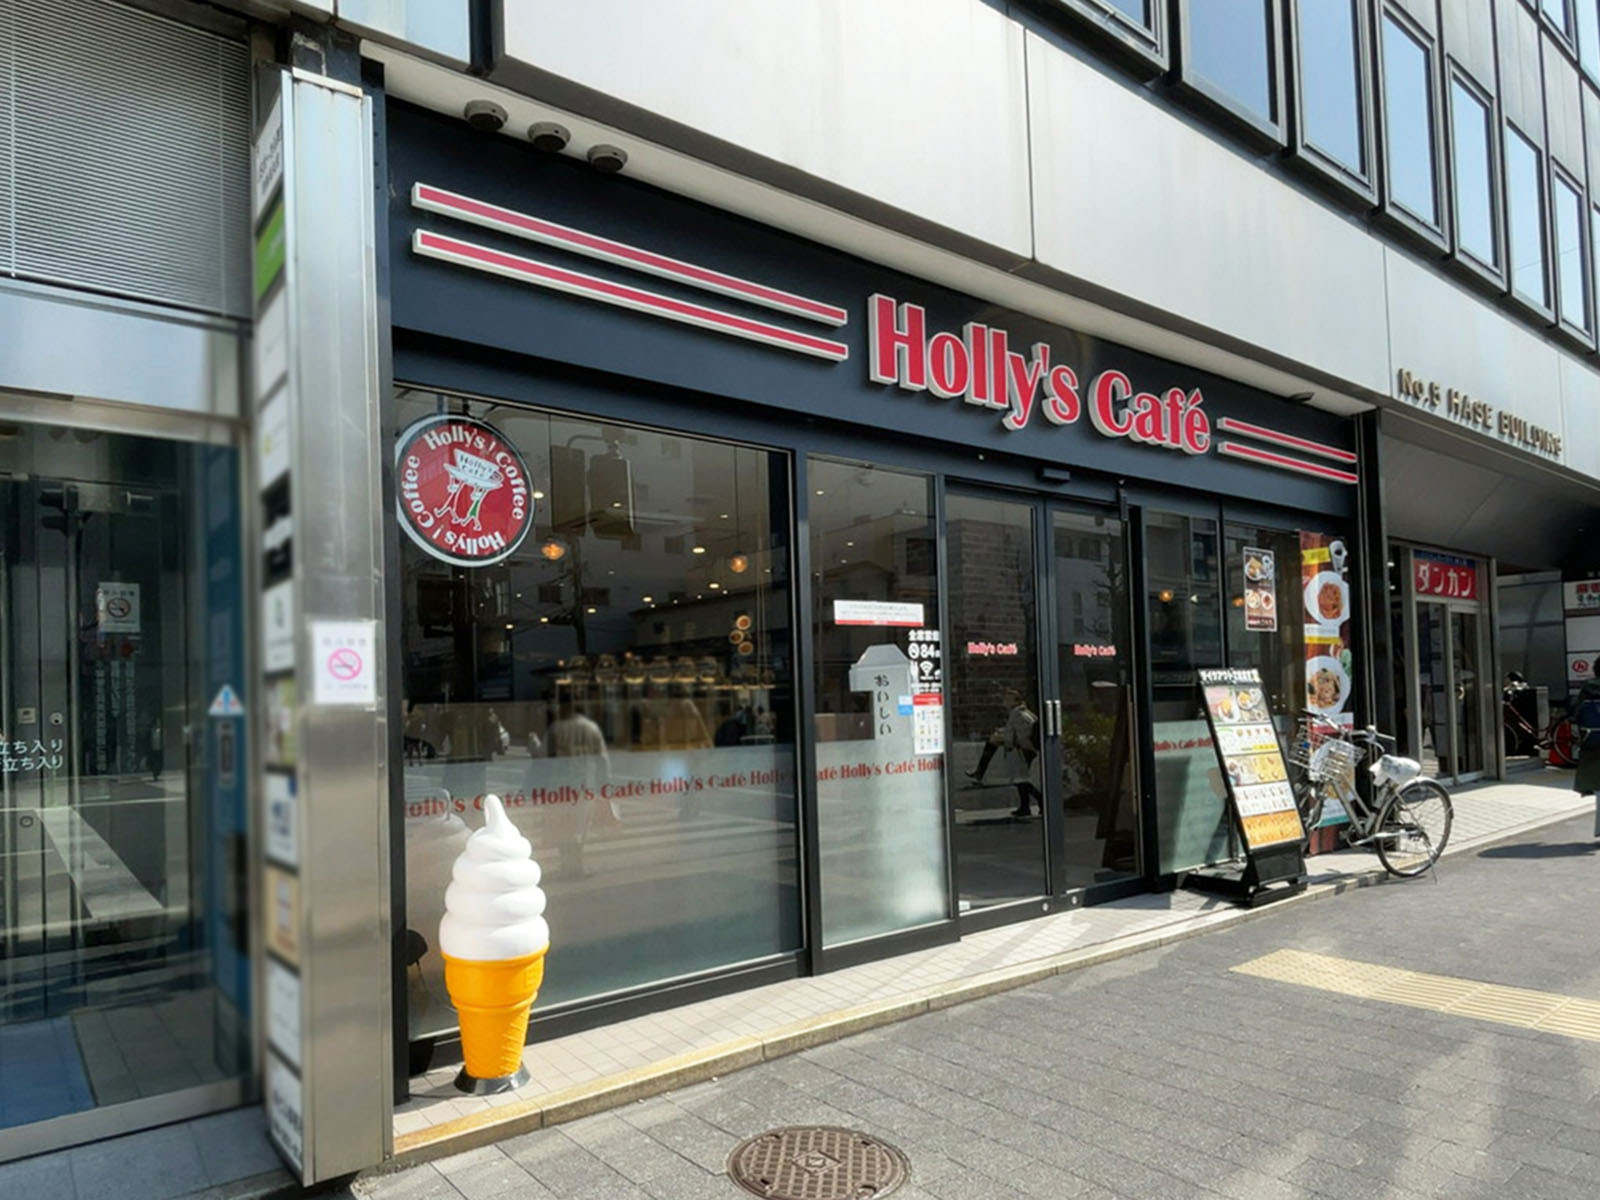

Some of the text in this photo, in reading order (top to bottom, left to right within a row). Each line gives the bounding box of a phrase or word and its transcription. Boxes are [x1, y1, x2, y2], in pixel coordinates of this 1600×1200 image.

[868, 292, 1211, 455] Holly's Café
[1446, 387, 1493, 430] HASE
[401, 455, 435, 529] Coffee
[422, 425, 486, 451] Holly's
[495, 451, 527, 520] Coffee
[444, 530, 506, 556] Holly's
[1418, 562, 1472, 597] ダンカン
[874, 674, 892, 736] おいしい
[473, 789, 526, 811] Cfé
[532, 783, 595, 806] Holly's
[602, 781, 645, 800] Café
[650, 775, 704, 797] Holly's
[708, 770, 747, 790] Café
[840, 762, 882, 780] Holly's
[885, 758, 915, 776] Café
